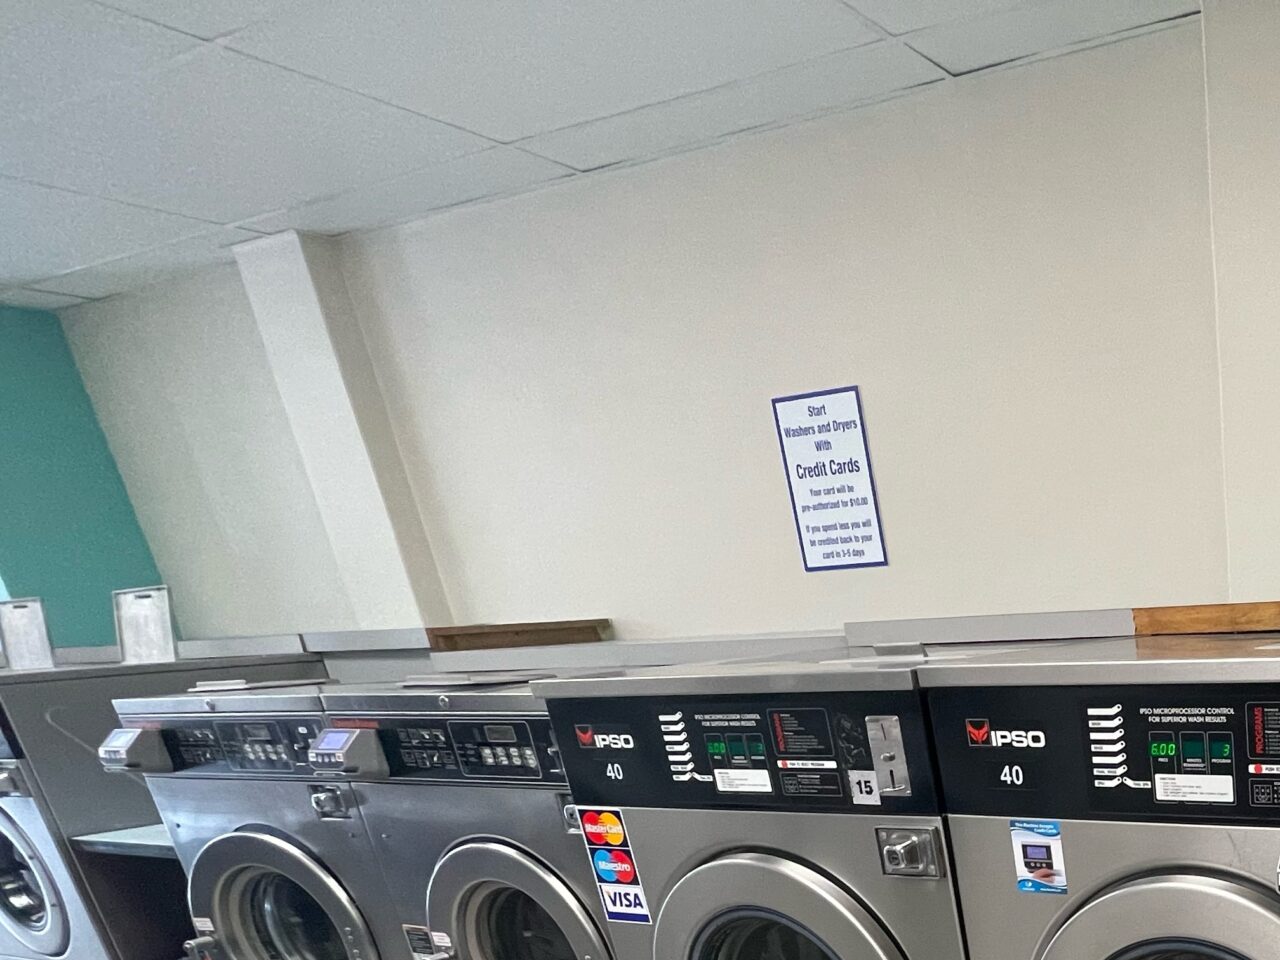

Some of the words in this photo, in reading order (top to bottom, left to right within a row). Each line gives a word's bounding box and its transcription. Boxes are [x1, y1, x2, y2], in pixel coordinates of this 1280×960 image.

[808, 404, 827, 417] Start
[784, 424, 816, 439] Washers
[817, 420, 831, 433] and
[832, 418, 858, 433] Dryers
[814, 439, 832, 452] With
[796, 461, 828, 480] Credit
[829, 457, 861, 476] Cards
[809, 487, 822, 497] Your
[823, 485, 835, 496] card
[836, 484, 846, 494] will
[847, 484, 854, 493] be
[841, 499, 849, 508] for
[849, 497, 869, 508] $10.00
[811, 525, 821, 535] you
[822, 522, 838, 534] spend
[839, 521, 850, 531] less
[851, 521, 861, 531] you
[862, 518, 872, 528] will
[809, 538, 816, 547] be
[840, 534, 853, 545] back
[854, 534, 859, 544] to
[860, 534, 873, 545] your
[823, 550, 835, 560] card
[852, 548, 865, 559] days
[593, 734, 635, 749] IPSO
[990, 730, 1046, 748] IPSO
[1151, 743, 1176, 755] 6.00
[1222, 744, 1230, 757] 3
[606, 763, 624, 780] 40
[1000, 765, 1024, 785] 40
[855, 780, 874, 796] 15
[598, 861, 631, 872] Maestro
[606, 890, 644, 909] VISA
